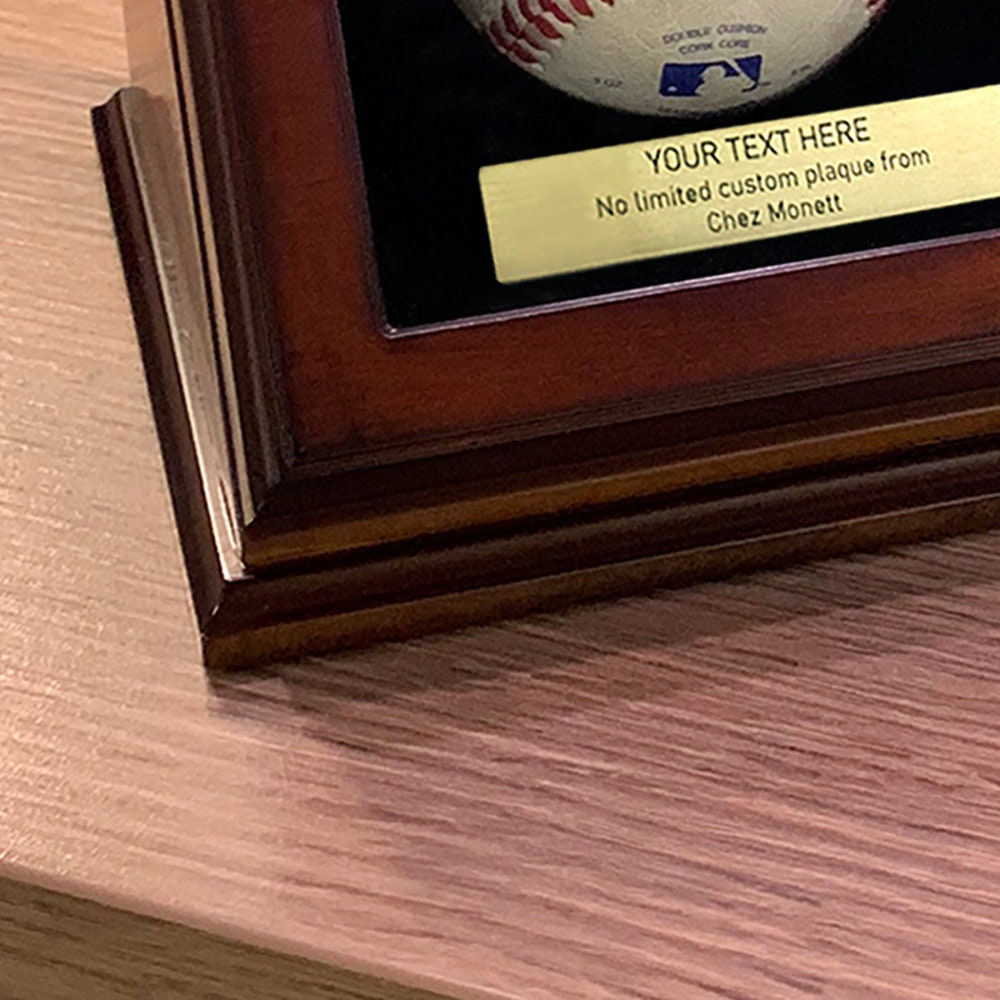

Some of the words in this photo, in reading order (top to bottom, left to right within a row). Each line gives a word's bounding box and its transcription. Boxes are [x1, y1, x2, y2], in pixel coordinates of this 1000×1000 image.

[645, 140, 721, 175] YOUR
[725, 128, 791, 162] TEXT
[798, 117, 871, 150] HERE
[596, 196, 628, 218] No
[633, 181, 713, 212] limited
[718, 170, 799, 199] custom
[804, 158, 876, 190] plaque
[880, 147, 931, 172] from
[707, 209, 761, 233] Chez
[768, 194, 844, 223] Monett
